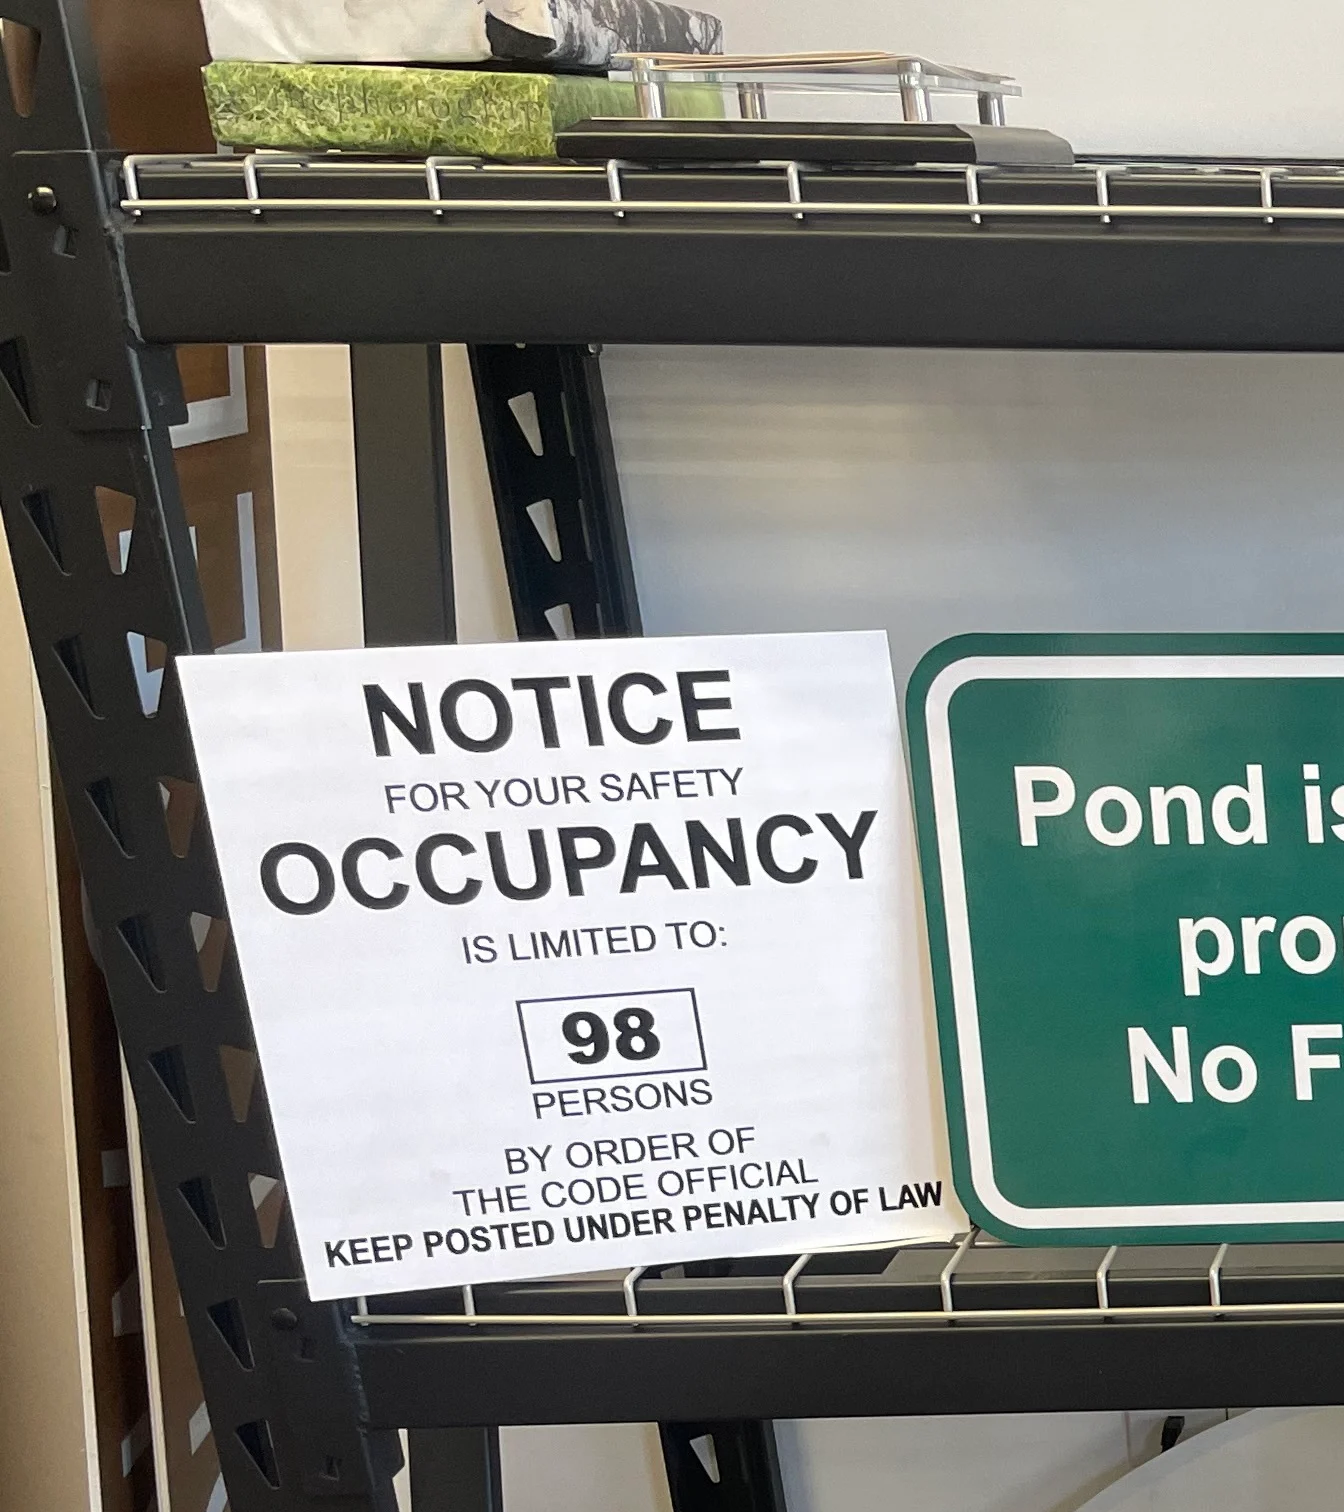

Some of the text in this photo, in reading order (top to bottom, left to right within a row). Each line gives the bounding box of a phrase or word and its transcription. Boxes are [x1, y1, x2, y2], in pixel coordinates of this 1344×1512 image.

[363, 670, 740, 757] NOTICE
[385, 768, 742, 813] FOR YOUR SAFETY
[1014, 765, 1267, 846] Pond
[260, 810, 878, 915] OCCUPANCY
[462, 921, 726, 964] IS LIMITED TO:
[562, 1008, 660, 1064] 98
[1128, 1027, 1257, 1103] No
[533, 1079, 712, 1119] PERSONS
[505, 1127, 754, 1174] BY ORDER OF
[453, 1159, 818, 1216] THE CODE OFFICIAL
[325, 1181, 942, 1267] KEEP POSTED UNDER PENALTY OF LAW
